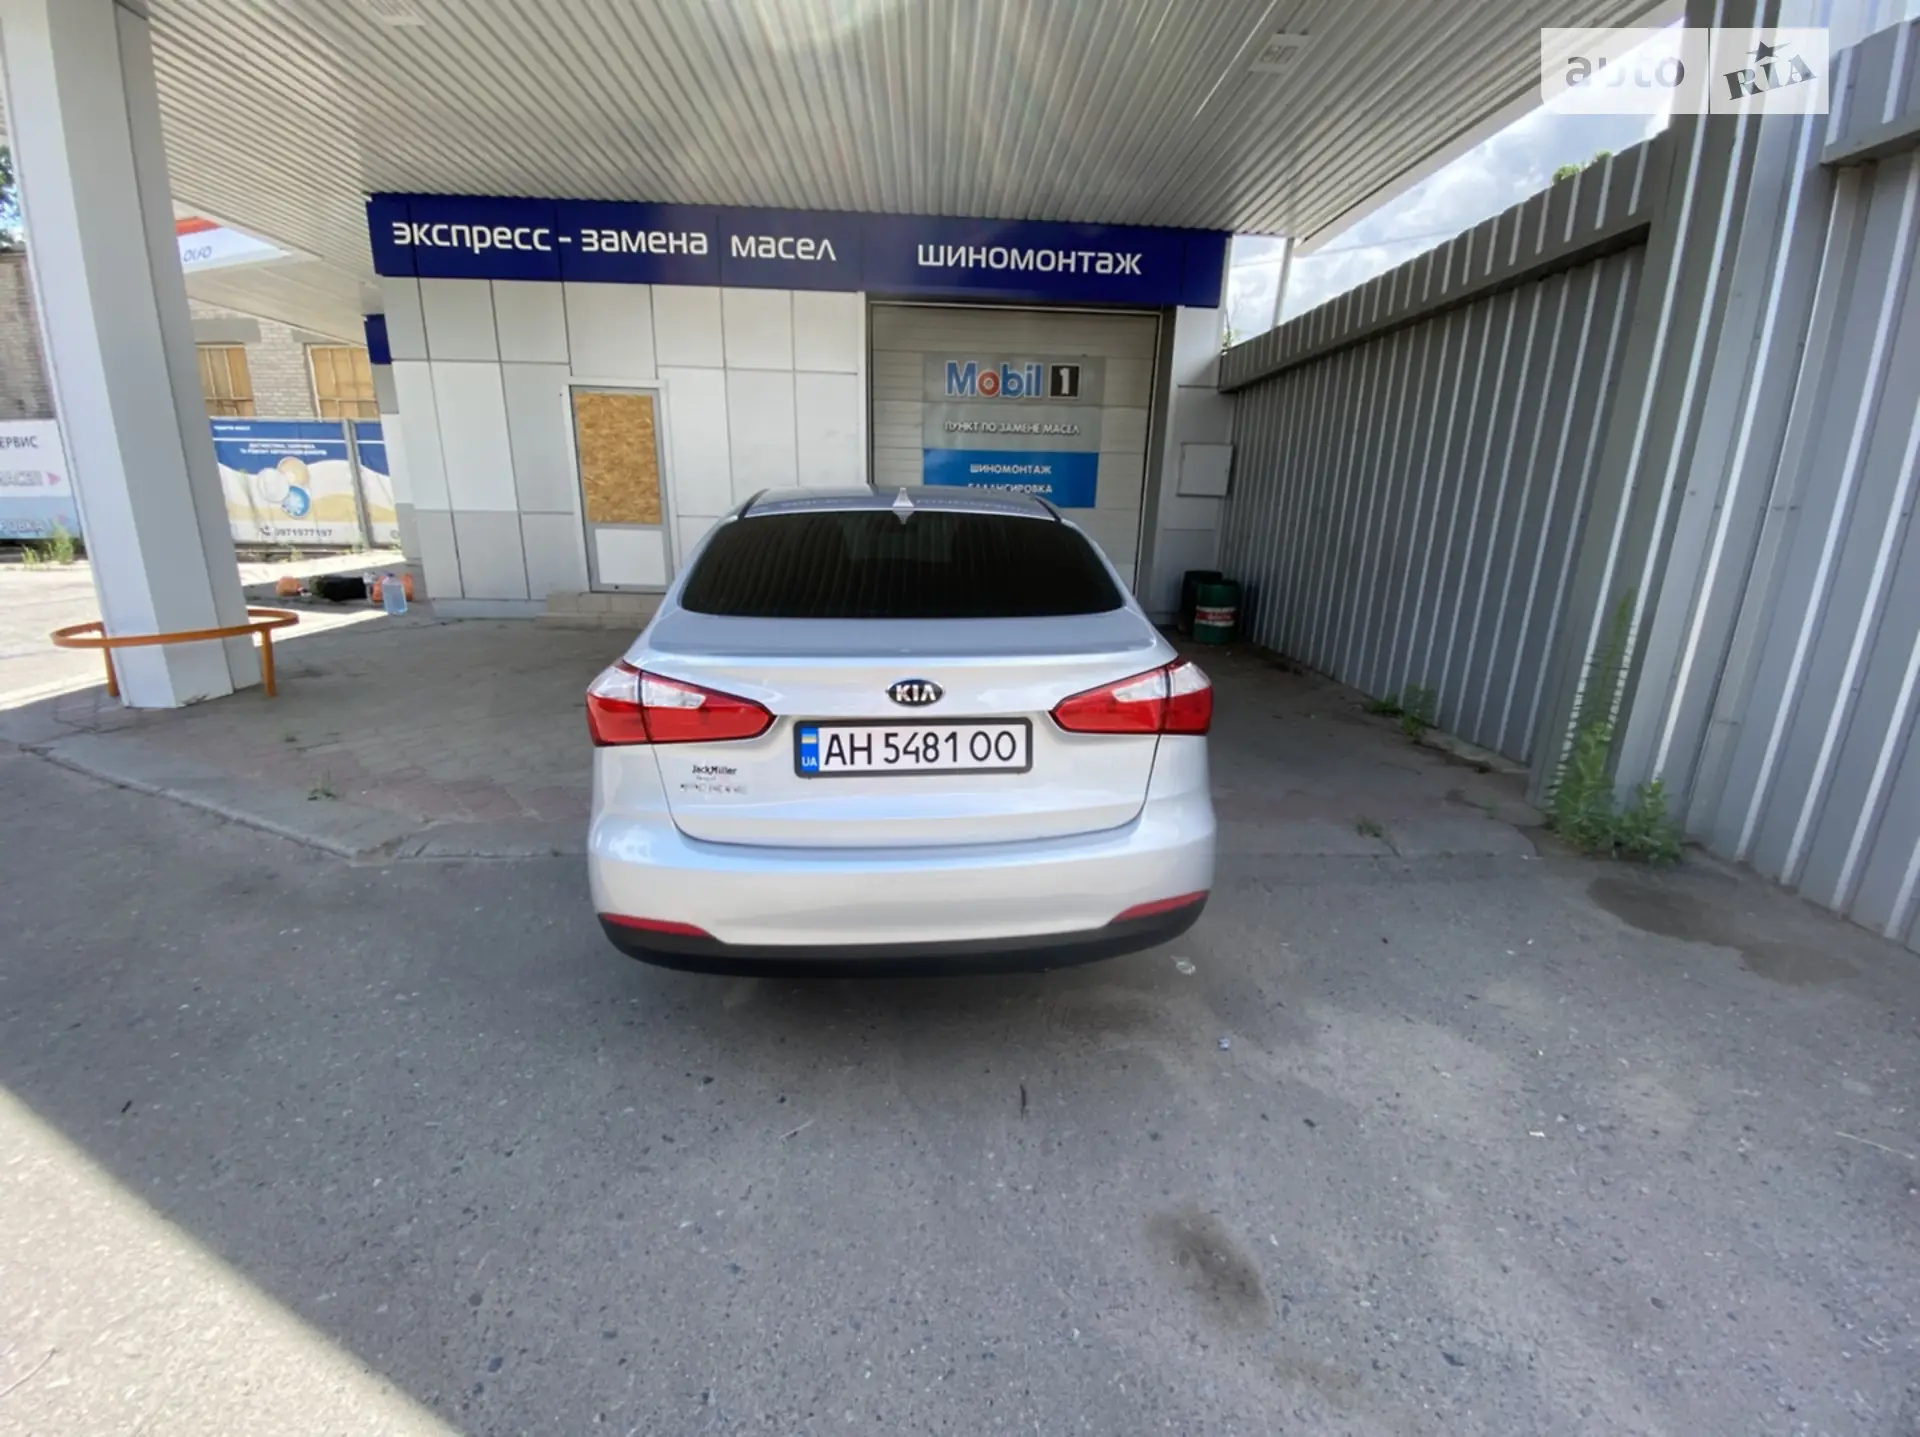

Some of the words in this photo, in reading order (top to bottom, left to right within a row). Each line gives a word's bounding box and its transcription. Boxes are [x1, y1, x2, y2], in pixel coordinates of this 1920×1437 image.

[392, 221, 551, 254] экспресс
[581, 229, 709, 255] замена
[731, 234, 837, 262] масел
[945, 360, 1043, 398] Mobil
[944, 420, 979, 432] ПУНКТ
[981, 421, 997, 433] ПО
[999, 422, 1041, 434] ЗАМЕНЕ
[1042, 423, 1080, 435] МАСЕЛ
[969, 463, 1052, 475] ШИНОМОНТАЖ
[895, 684, 937, 702] KIA
[824, 732, 872, 765] AH
[883, 731, 957, 764] 5481
[801, 756, 818, 767] UA
